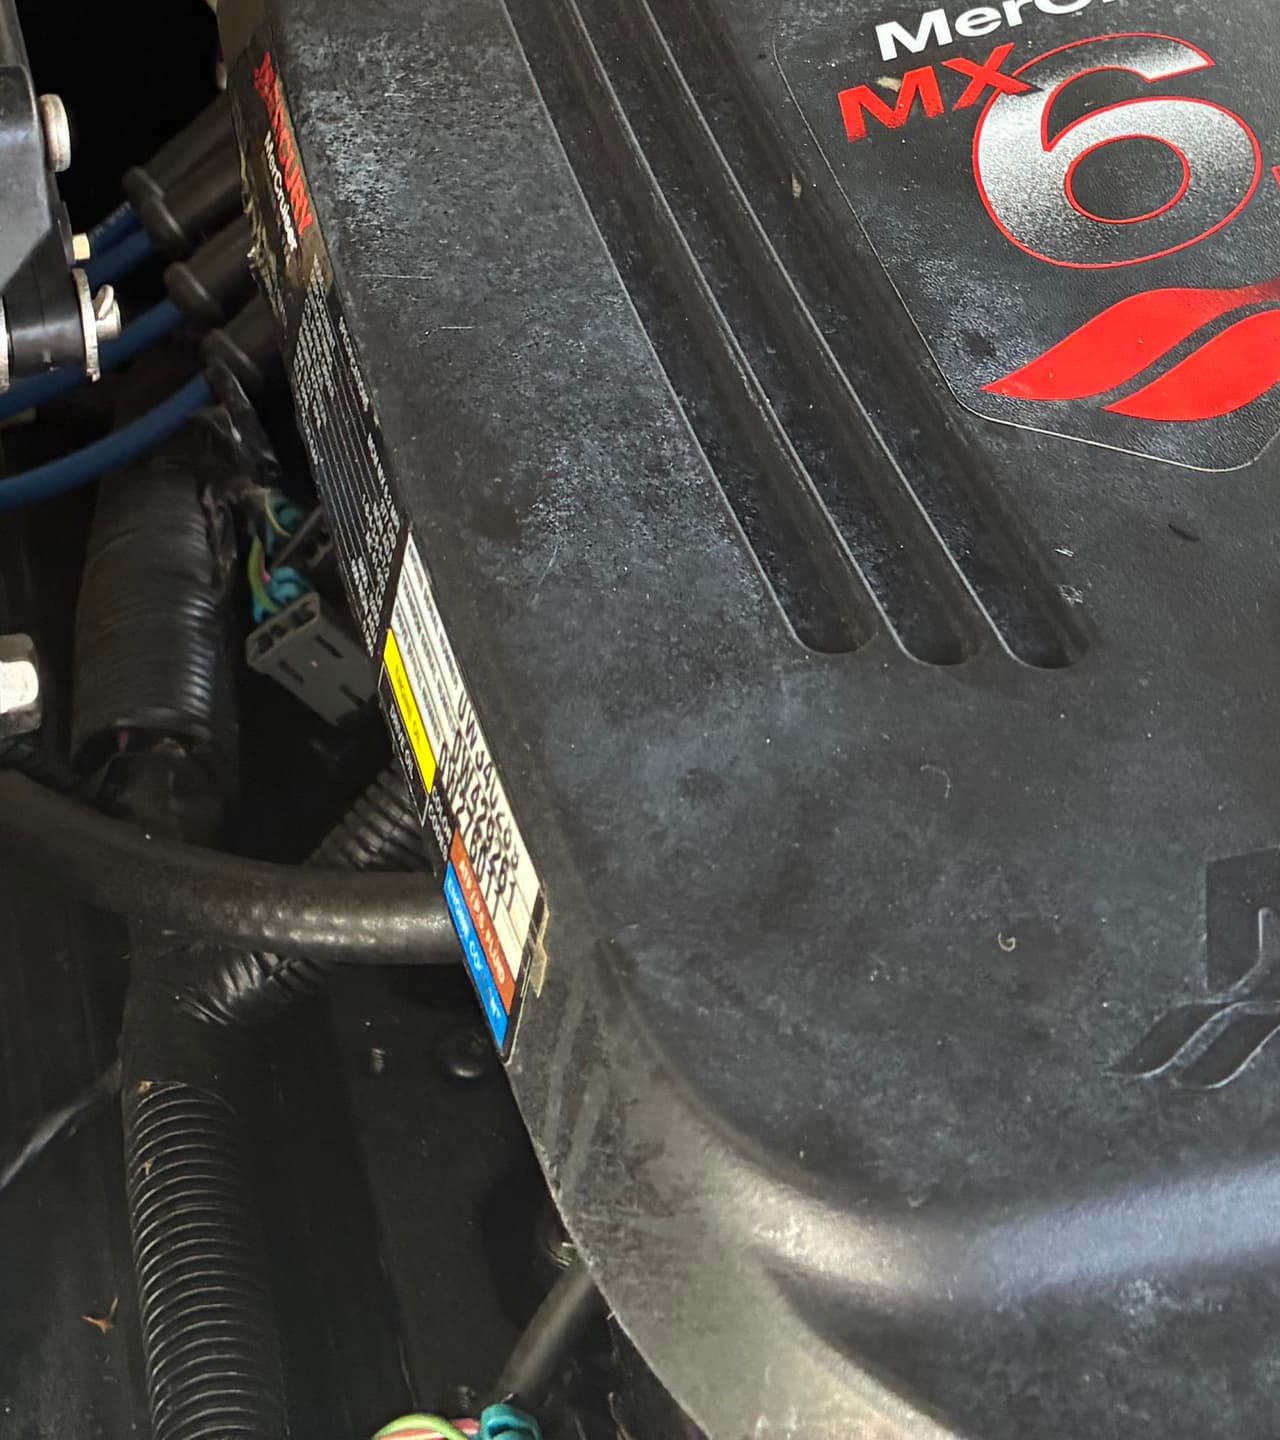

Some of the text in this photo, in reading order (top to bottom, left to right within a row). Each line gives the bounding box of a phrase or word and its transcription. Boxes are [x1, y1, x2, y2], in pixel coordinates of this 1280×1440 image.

[837, 42, 1040, 143] MX
[388, 699, 415, 784] DRIVE OIL
[427, 799, 449, 865] CODES
[431, 781, 452, 848] COLOR
[483, 924, 506, 991] FLUID
